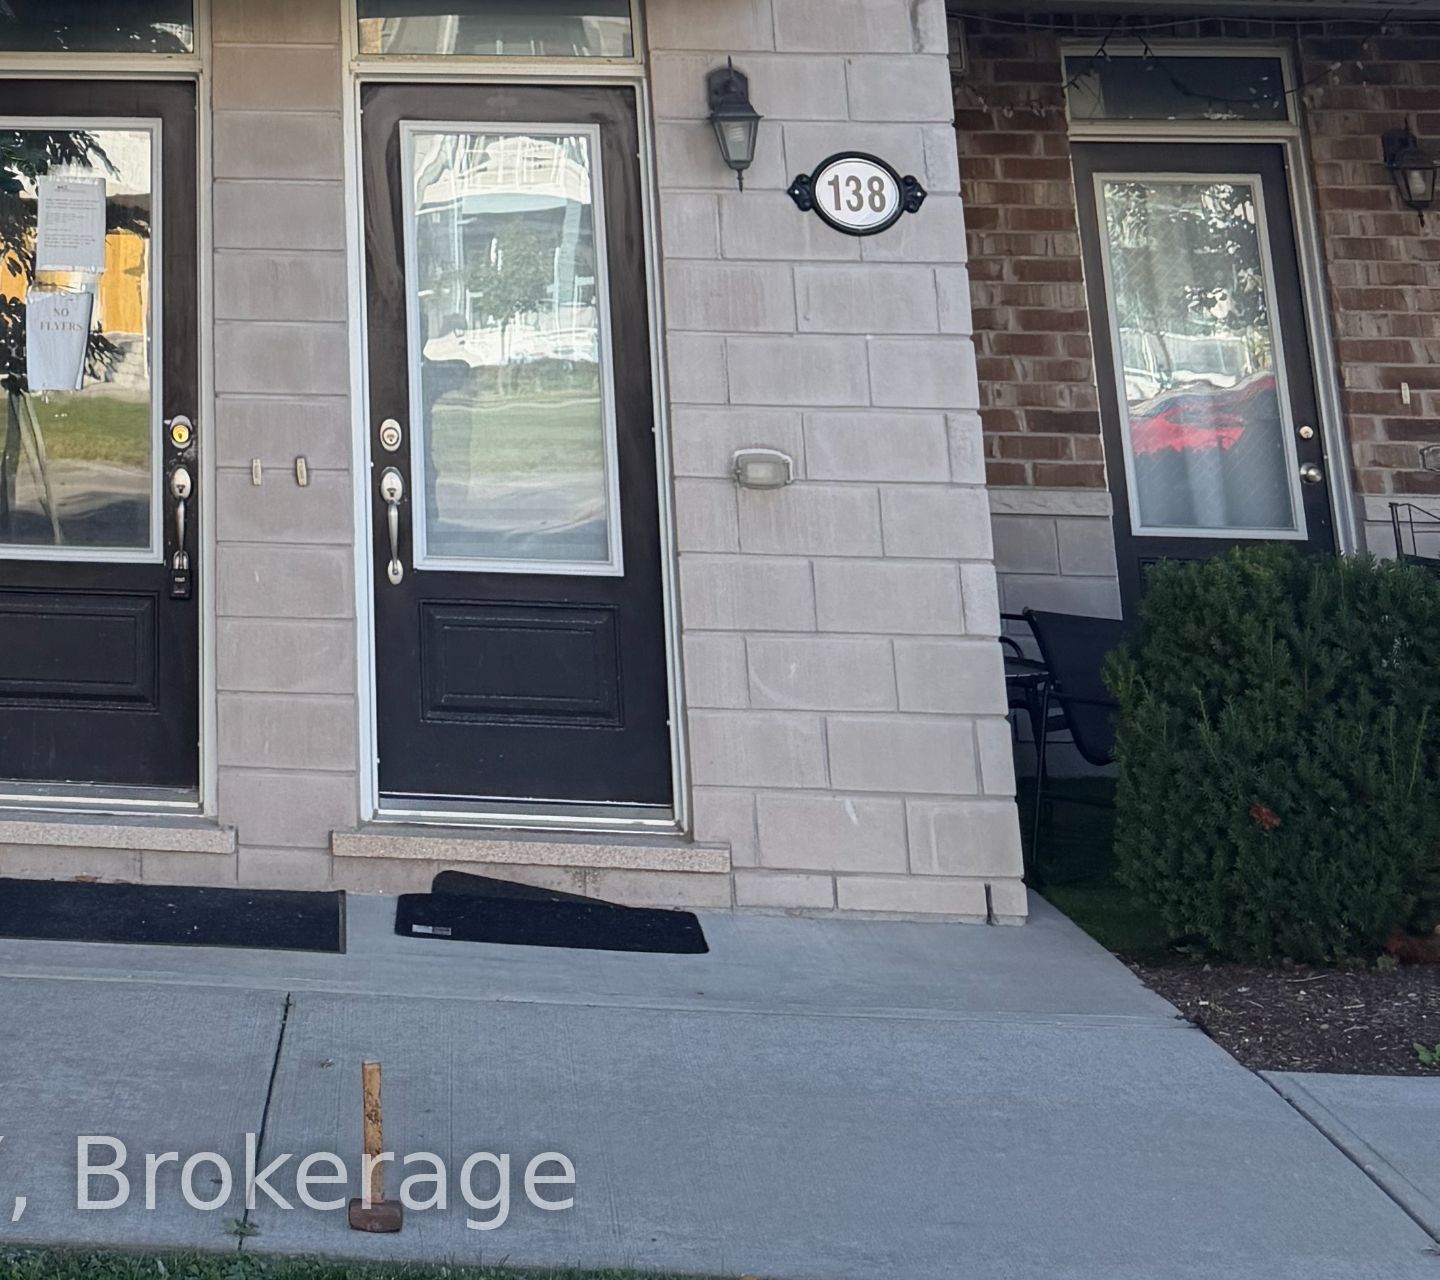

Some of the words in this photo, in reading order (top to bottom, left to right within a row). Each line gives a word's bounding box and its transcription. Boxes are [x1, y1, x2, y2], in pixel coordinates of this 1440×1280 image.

[827, 174, 887, 213] 138
[53, 307, 70, 317] NO
[40, 321, 83, 331] FLYERS
